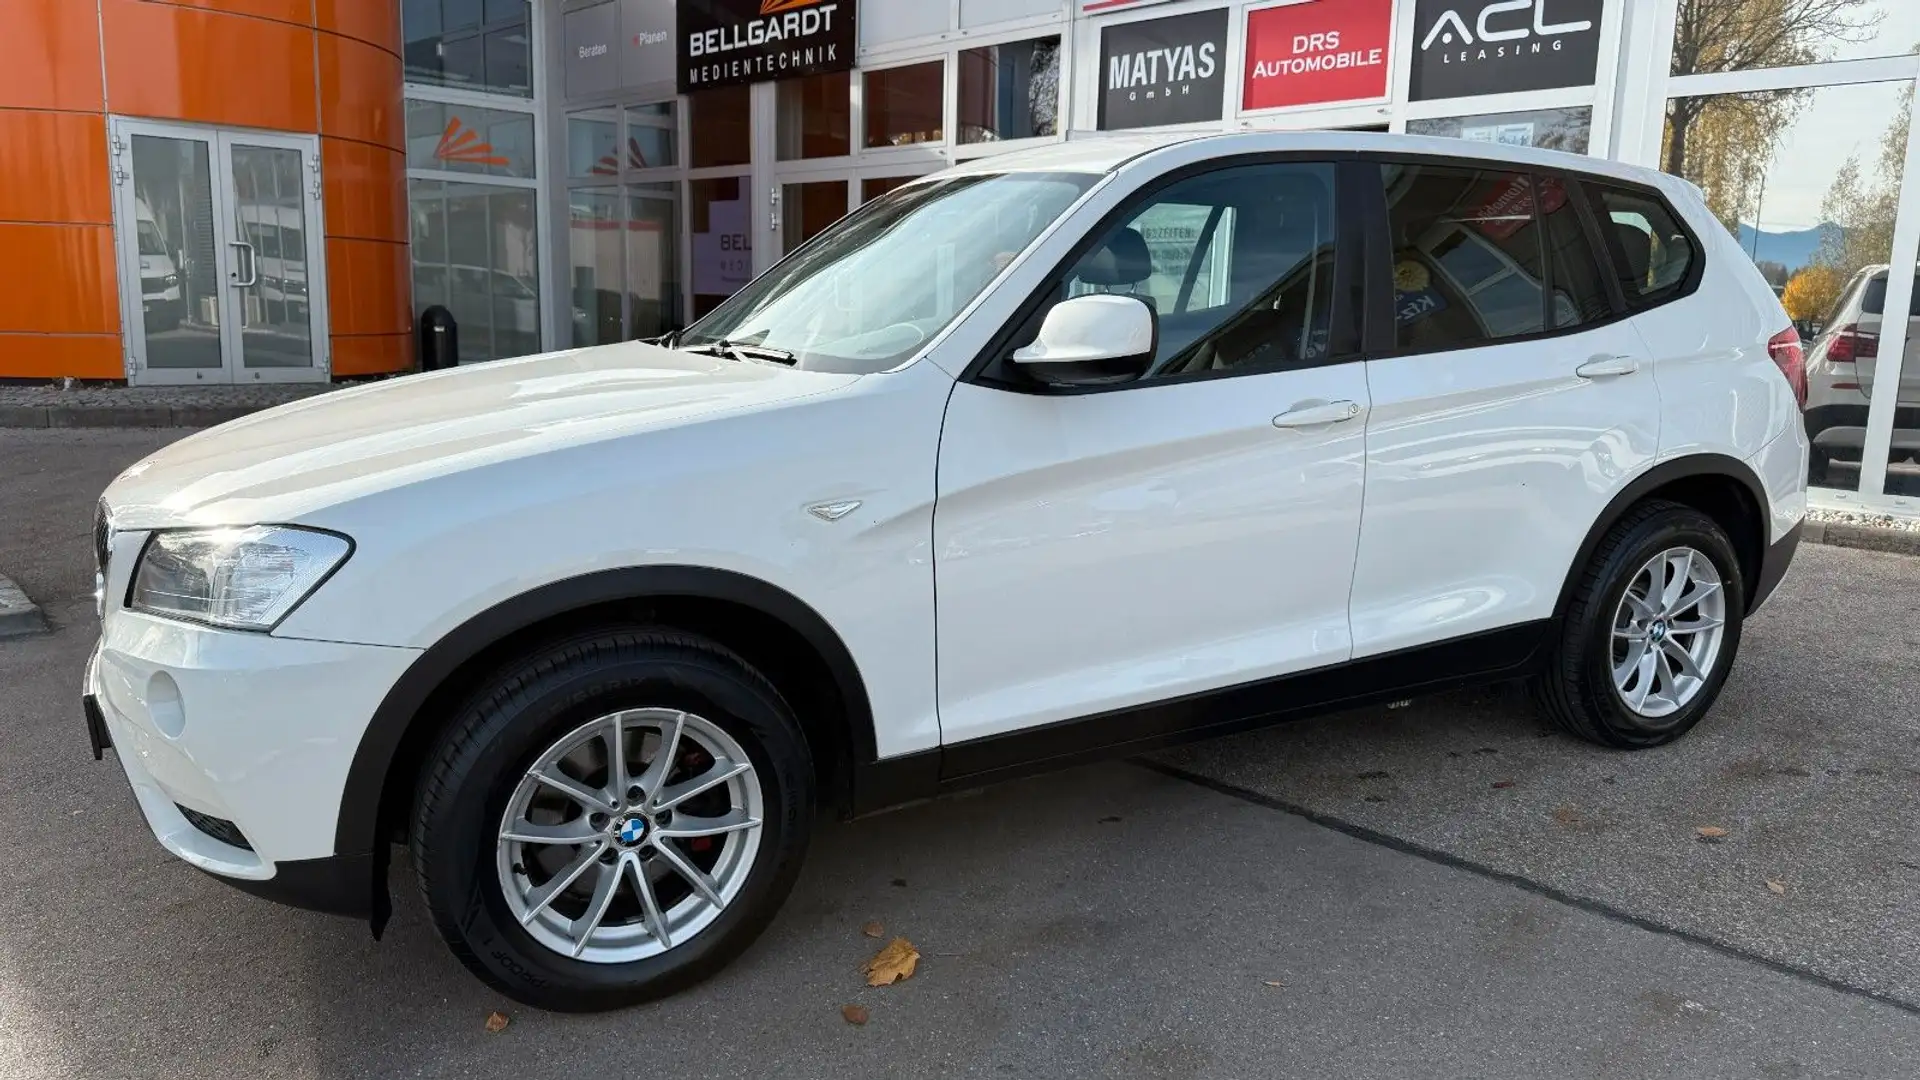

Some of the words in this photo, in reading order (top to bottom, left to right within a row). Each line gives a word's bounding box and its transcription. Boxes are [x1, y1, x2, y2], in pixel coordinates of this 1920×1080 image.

[639, 31, 667, 46] Planen
[690, 4, 837, 57] BELLGARDT
[1421, 0, 1592, 50] ACL
[579, 44, 607, 58] Beraten
[1292, 31, 1340, 54] DRS
[1443, 40, 1562, 63] LEASING
[690, 43, 837, 84] MEDIENTECHNIK
[1109, 42, 1215, 90] MATYAS
[1252, 48, 1382, 79] AUTOMOBILE
[1129, 84, 1190, 101] GmbH
